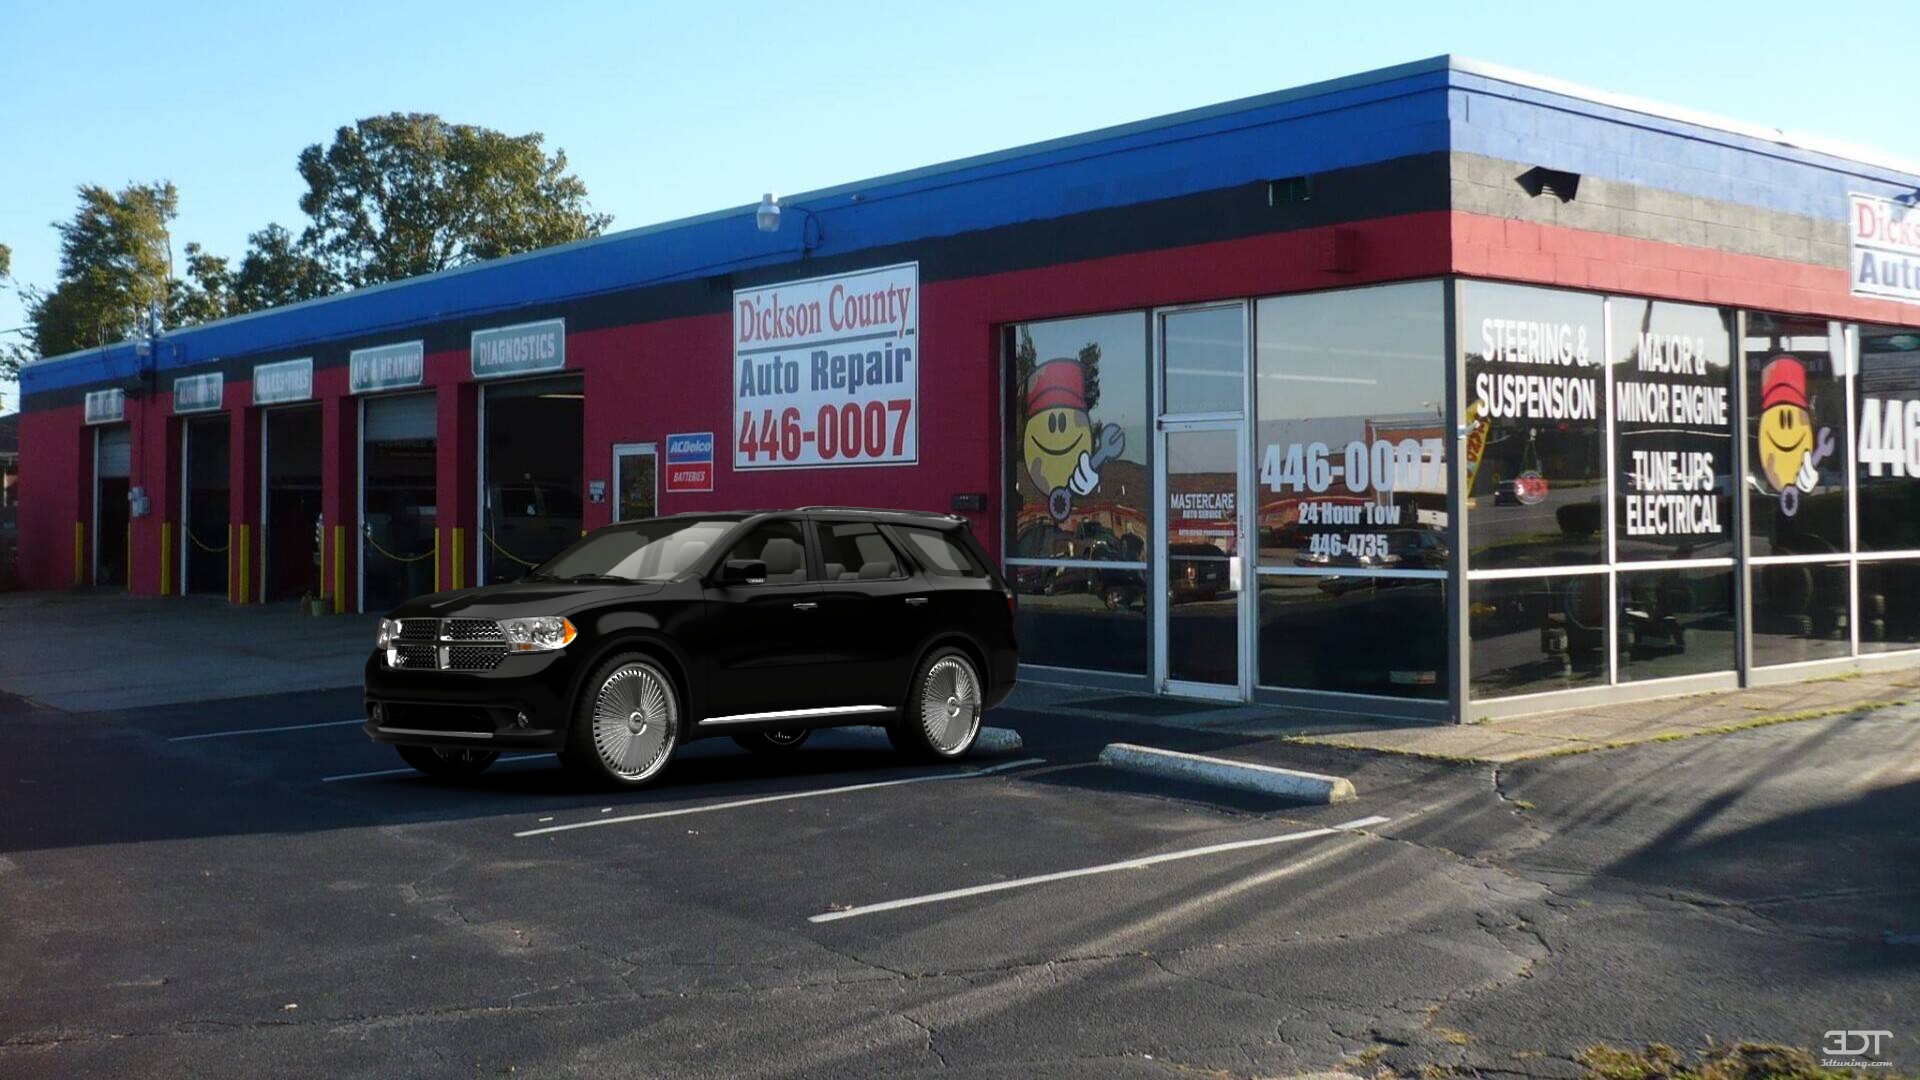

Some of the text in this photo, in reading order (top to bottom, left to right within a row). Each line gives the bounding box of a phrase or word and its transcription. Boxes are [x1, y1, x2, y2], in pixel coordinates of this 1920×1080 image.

[739, 282, 911, 343] Dickson County
[479, 332, 556, 366] DIAGNOSTICS
[1481, 318, 1589, 367] STEERING &
[1638, 331, 1706, 375] MAJOR &
[380, 353, 420, 380] HEATING
[739, 342, 912, 398] Auto Repair
[1475, 373, 1596, 420] SUSPENSION
[1616, 381, 1728, 426] MINOR ENGINE
[670, 439, 711, 454] ACDelco
[739, 399, 912, 462] 446-0007
[673, 471, 705, 482] BATTERIES
[1260, 437, 1444, 493] 446-0007
[1632, 450, 1714, 491] TUNE-UPS
[1170, 493, 1235, 509] MASTERCARE
[1298, 503, 1400, 526] 24 Hour Tow
[1626, 494, 1722, 536] ELECTRICAL
[1309, 533, 1389, 557] 446-4735
